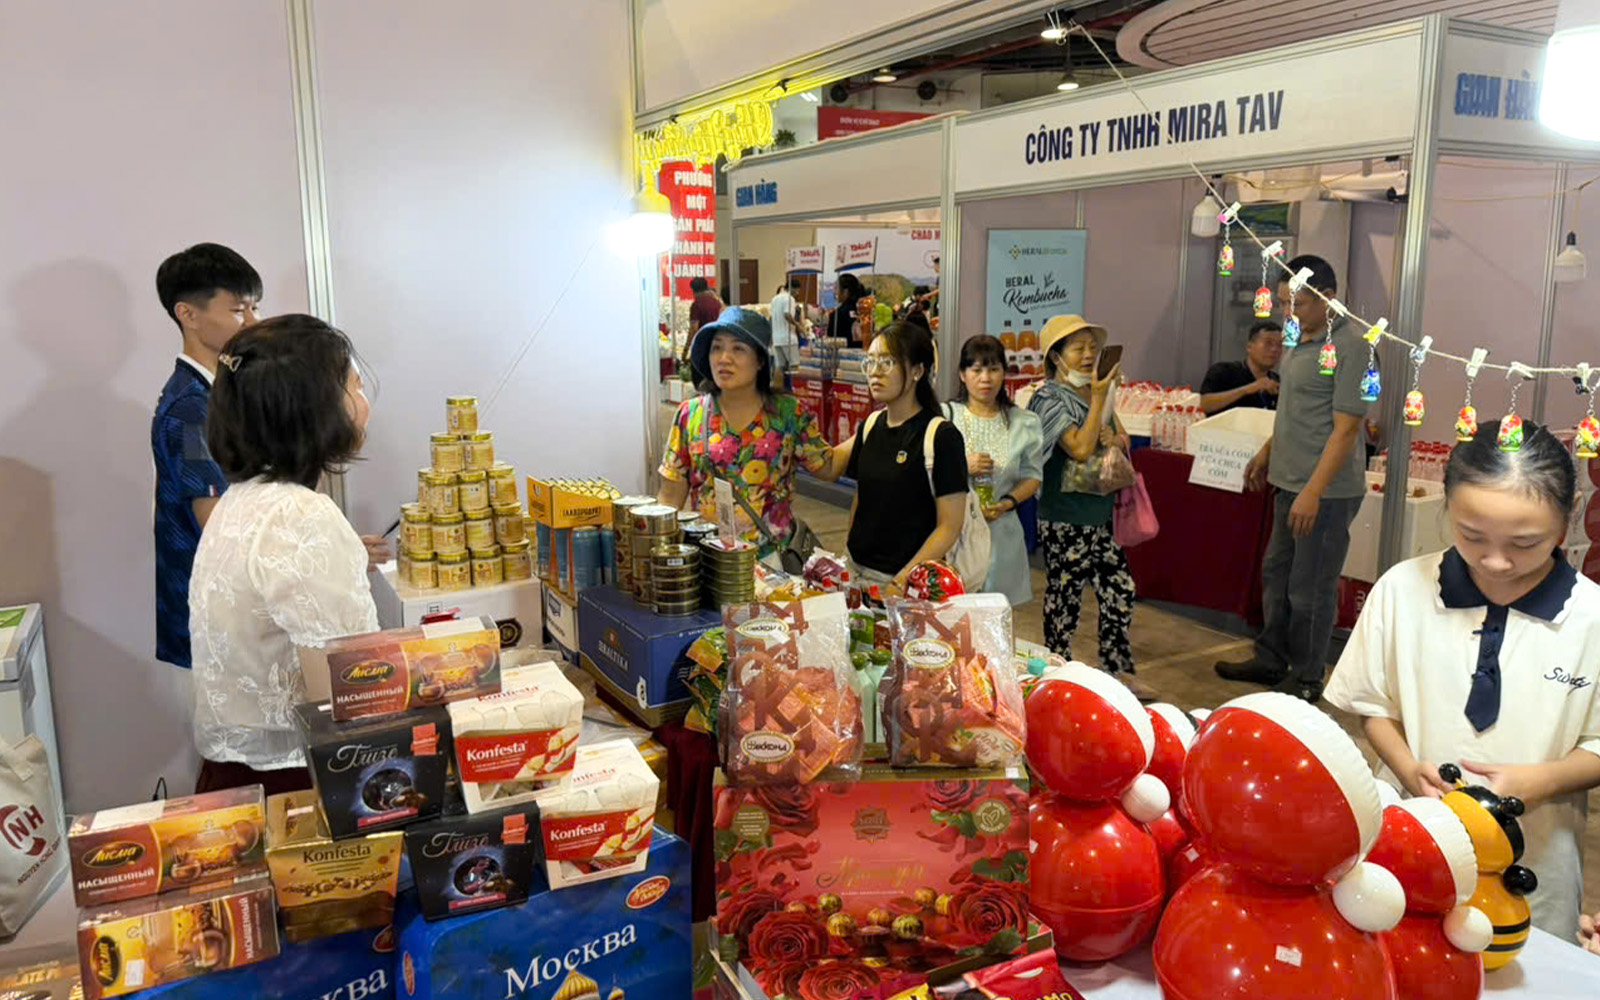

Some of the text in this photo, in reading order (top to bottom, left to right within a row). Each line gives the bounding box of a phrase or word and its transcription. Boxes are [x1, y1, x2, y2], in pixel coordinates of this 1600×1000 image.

[1025, 90, 1284, 165] CÔNG TY TNHH MIRA TAV
[1005, 275, 1036, 288] HERAL
[1002, 285, 1068, 314] Kombucha
[466, 741, 527, 762] Konfesta
[550, 821, 607, 841] Konfesta
[303, 845, 372, 863] Konfesta
